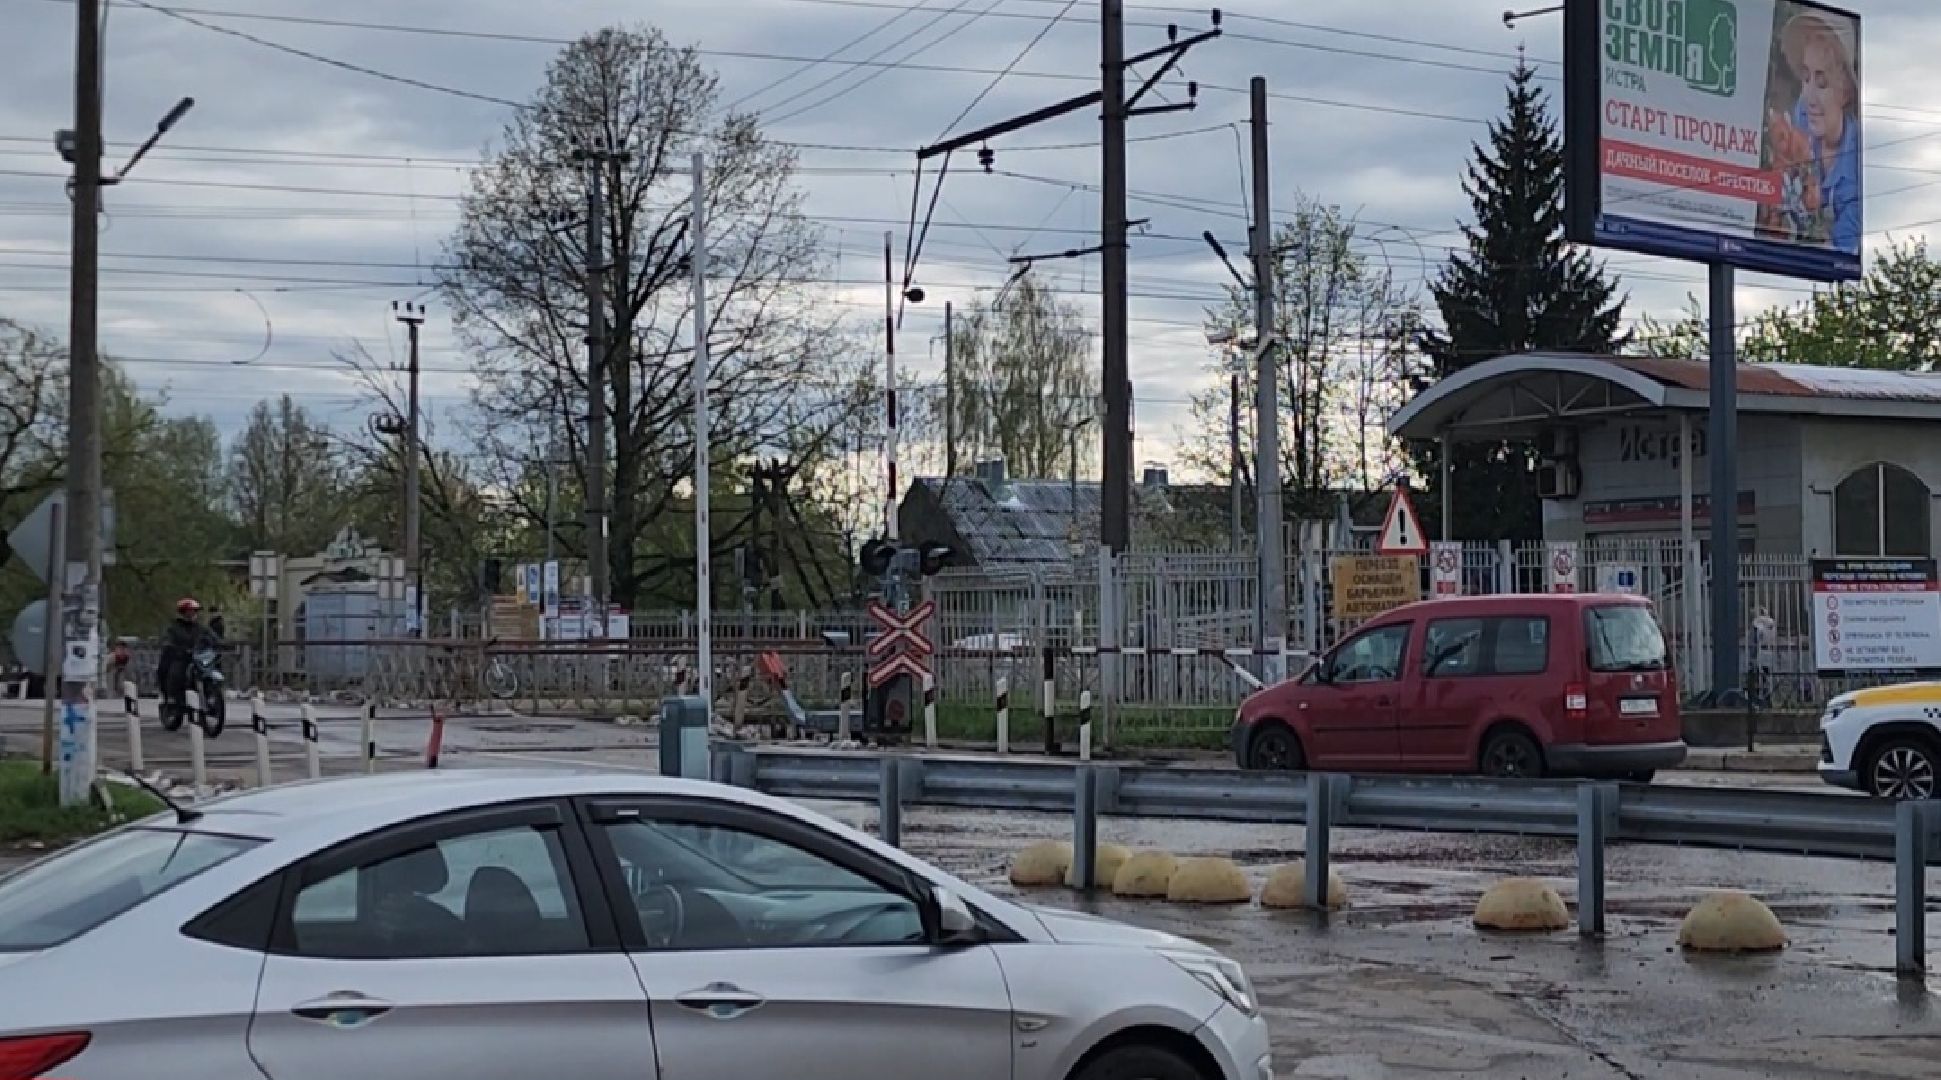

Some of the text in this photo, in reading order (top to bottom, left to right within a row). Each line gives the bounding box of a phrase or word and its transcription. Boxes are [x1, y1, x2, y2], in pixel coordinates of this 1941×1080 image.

[1606, 0, 1683, 38] СВОЯ
[1606, 66, 1647, 93] ИСТРА
[1605, 99, 1758, 155] СТАРТ ПРОДАЖ
[1606, 149, 1658, 173] ДАЧНЫЙ
[1356, 558, 1399, 571] ПЕРЕЕЗД
